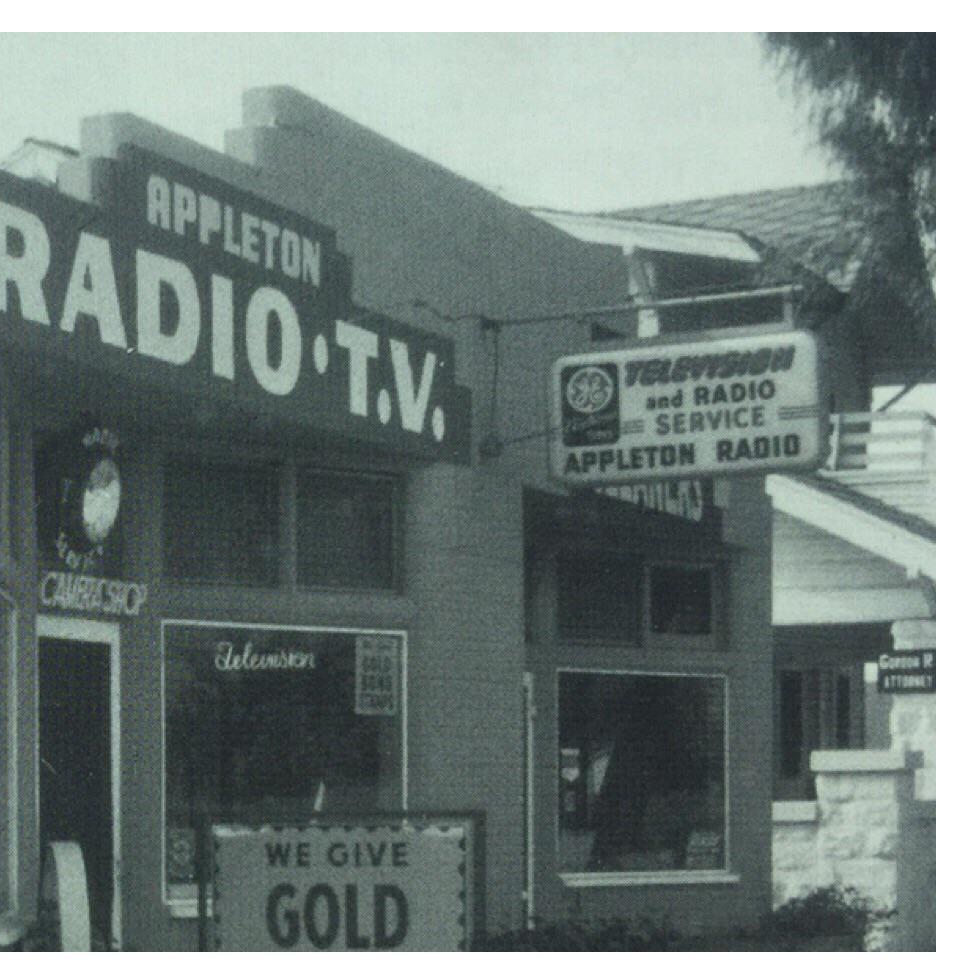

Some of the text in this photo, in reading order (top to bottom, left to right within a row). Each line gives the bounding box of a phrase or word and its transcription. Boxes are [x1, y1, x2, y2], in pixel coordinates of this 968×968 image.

[146, 174, 321, 288] APPLETON
[624, 345, 796, 387] TELEVISION
[645, 379, 777, 410] and RADIO
[654, 405, 765, 435] SERVICE
[564, 433, 802, 475] APPLETON RADIO
[265, 842, 410, 868] WE GIVE
[266, 882, 410, 950] GOLD
